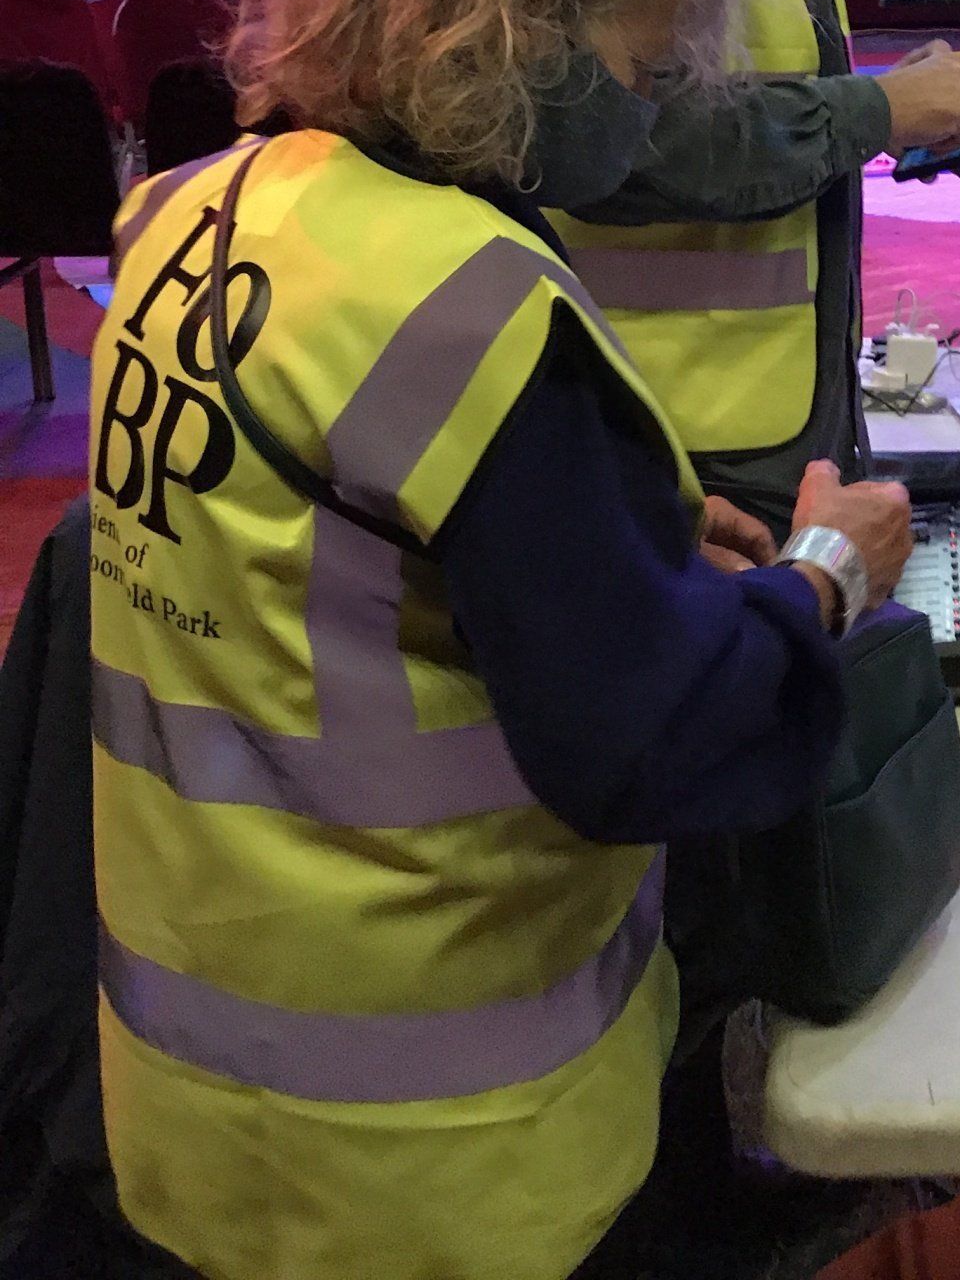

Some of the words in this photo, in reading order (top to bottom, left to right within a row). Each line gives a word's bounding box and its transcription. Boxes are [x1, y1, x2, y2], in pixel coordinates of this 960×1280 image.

[95, 340, 236, 545] BP
[125, 542, 149, 568] of
[161, 596, 222, 639] Park
